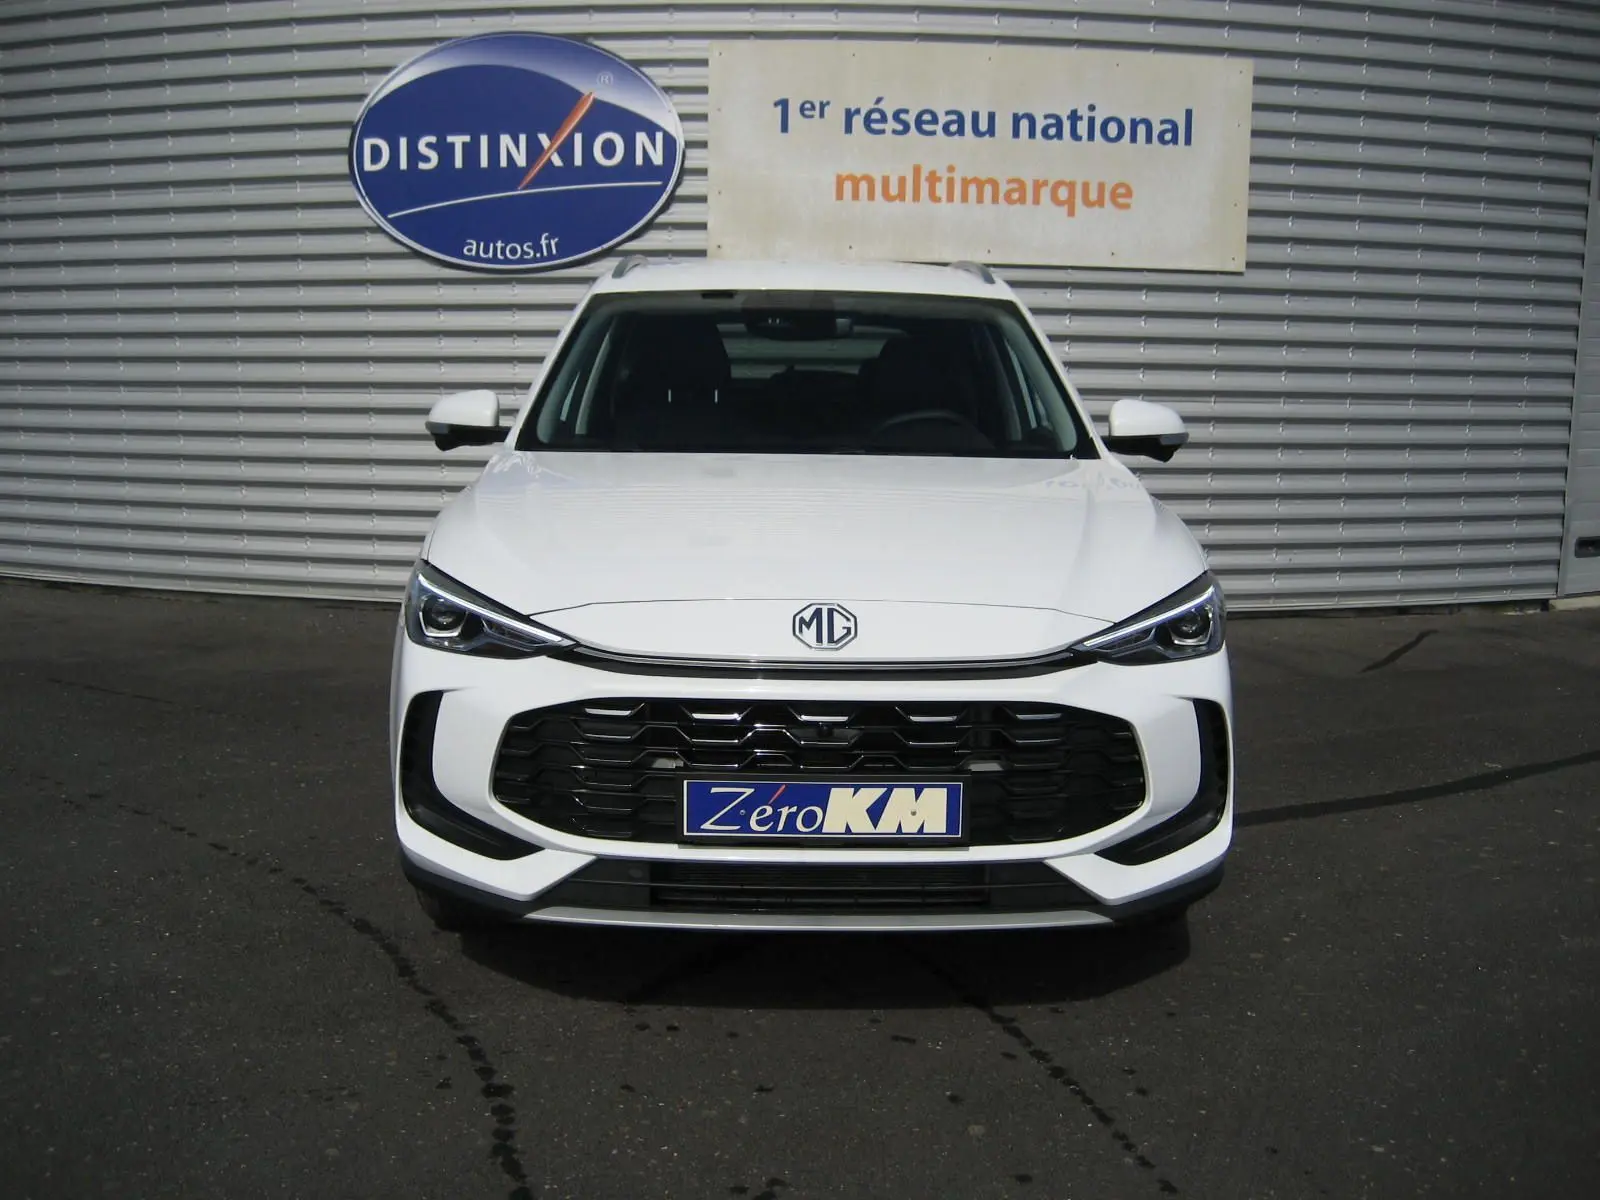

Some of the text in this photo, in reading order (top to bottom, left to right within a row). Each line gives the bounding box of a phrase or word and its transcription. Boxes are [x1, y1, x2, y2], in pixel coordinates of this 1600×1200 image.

[843, 97, 996, 138] réseau
[1011, 104, 1194, 146] national
[363, 131, 664, 172] DISTINXION
[834, 165, 1133, 217] multimarque
[463, 233, 560, 260] autos.fr
[798, 607, 852, 645] MG
